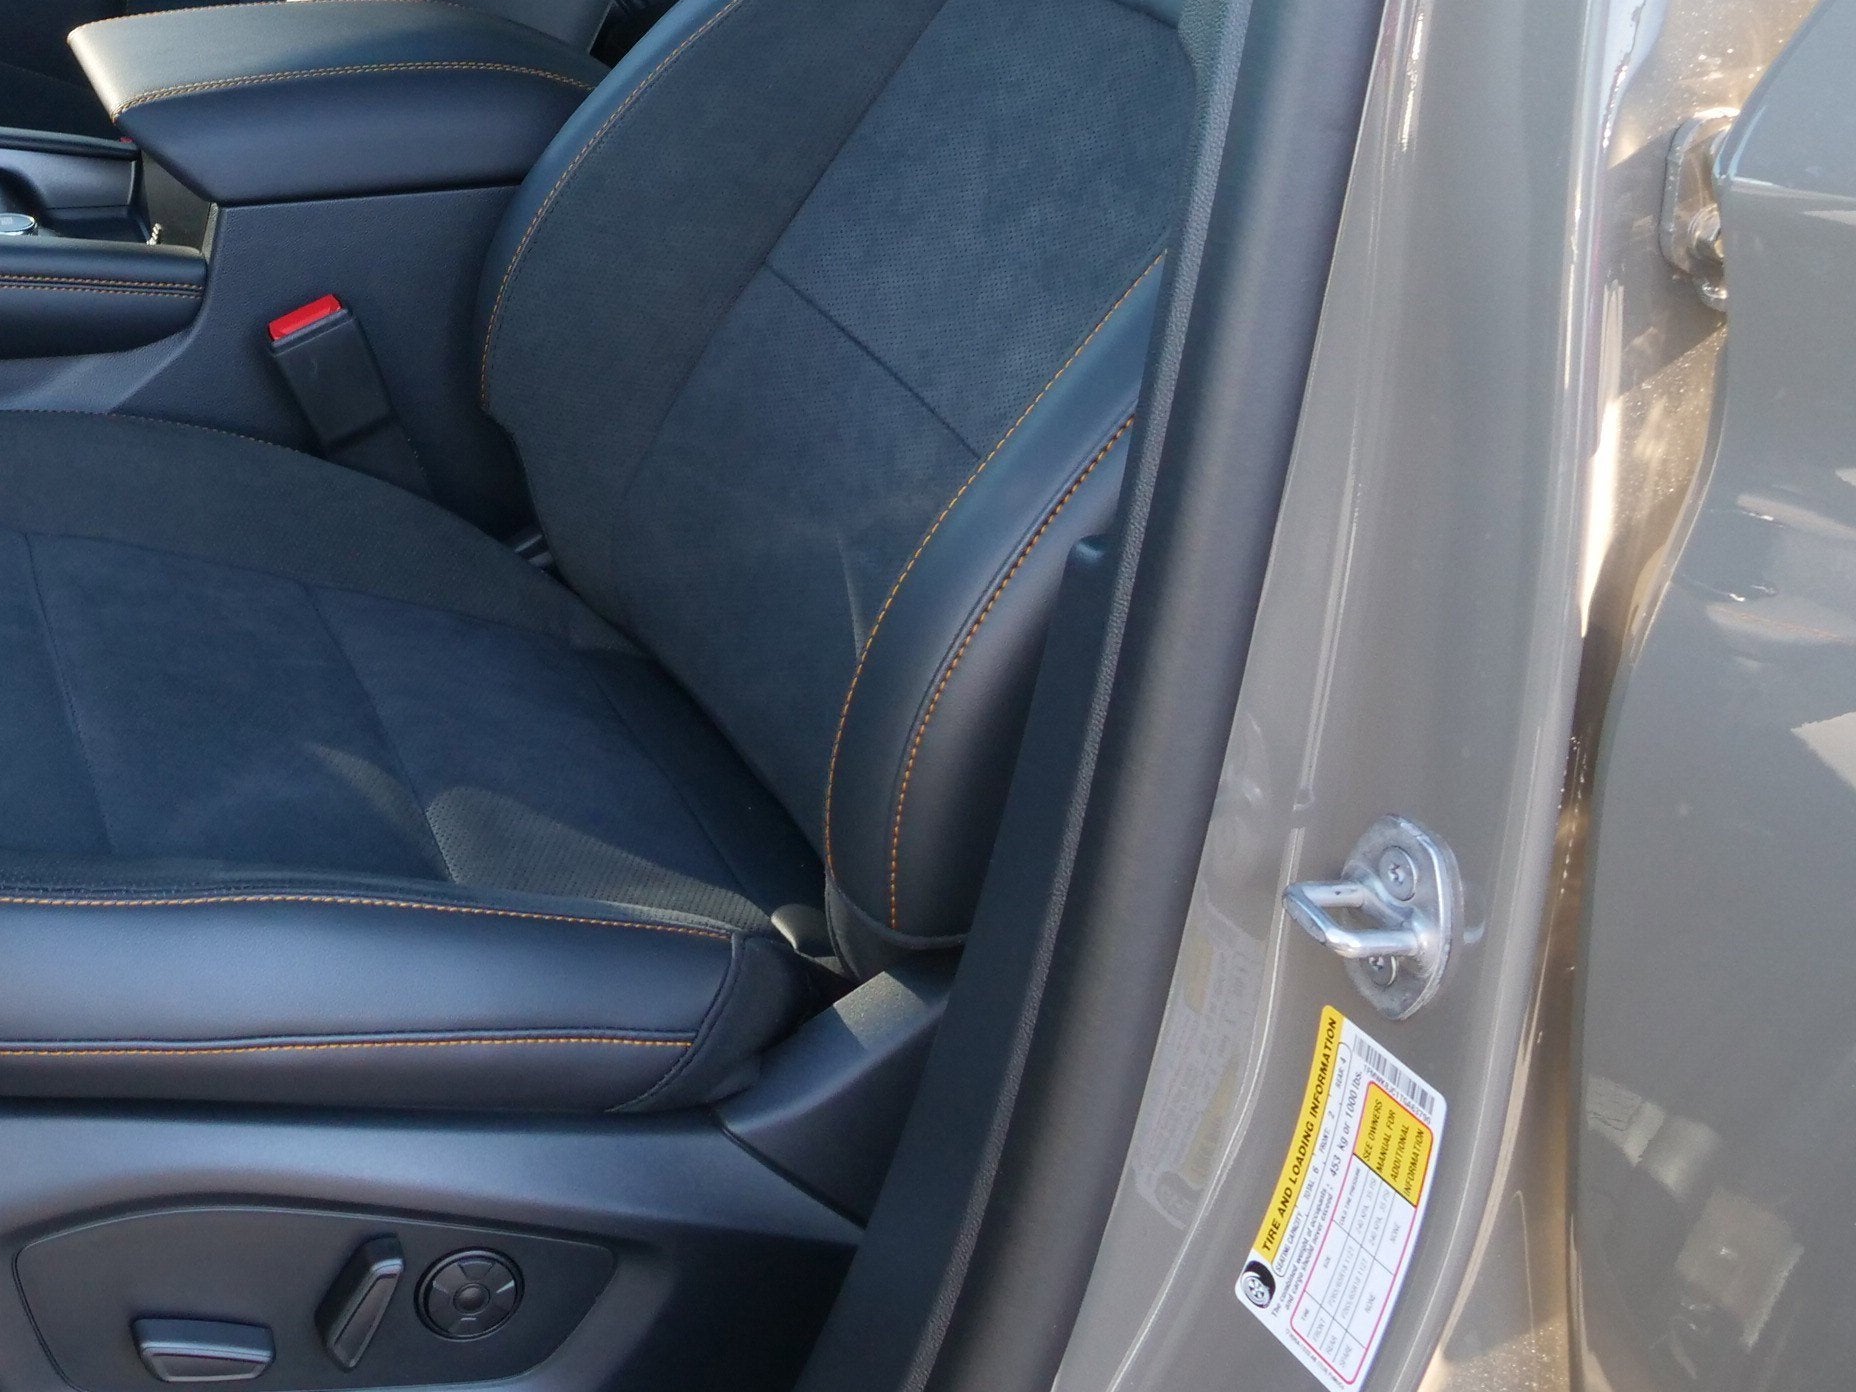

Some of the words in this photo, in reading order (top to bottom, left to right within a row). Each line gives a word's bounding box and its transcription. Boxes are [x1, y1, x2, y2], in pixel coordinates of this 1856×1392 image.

[1346, 1089, 1358, 1118] 1000
[1368, 1098, 1383, 1141] OWNERS
[1263, 1218, 1280, 1251] TIRE
[1277, 1187, 1292, 1217] AND
[1289, 1120, 1315, 1184] LOADING
[1309, 1017, 1336, 1118] INFORMATION
[1338, 1134, 1348, 1152] kg
[1344, 1122, 1351, 1134] or
[1376, 1131, 1391, 1173] MANUAL
[1387, 1109, 1396, 1131] FOR
[1329, 1154, 1341, 1177] 453
[1364, 1140, 1373, 1161] SEE
[1391, 1123, 1409, 1182] ADDITIONAL
[1404, 1128, 1425, 1197] INFORMATION
